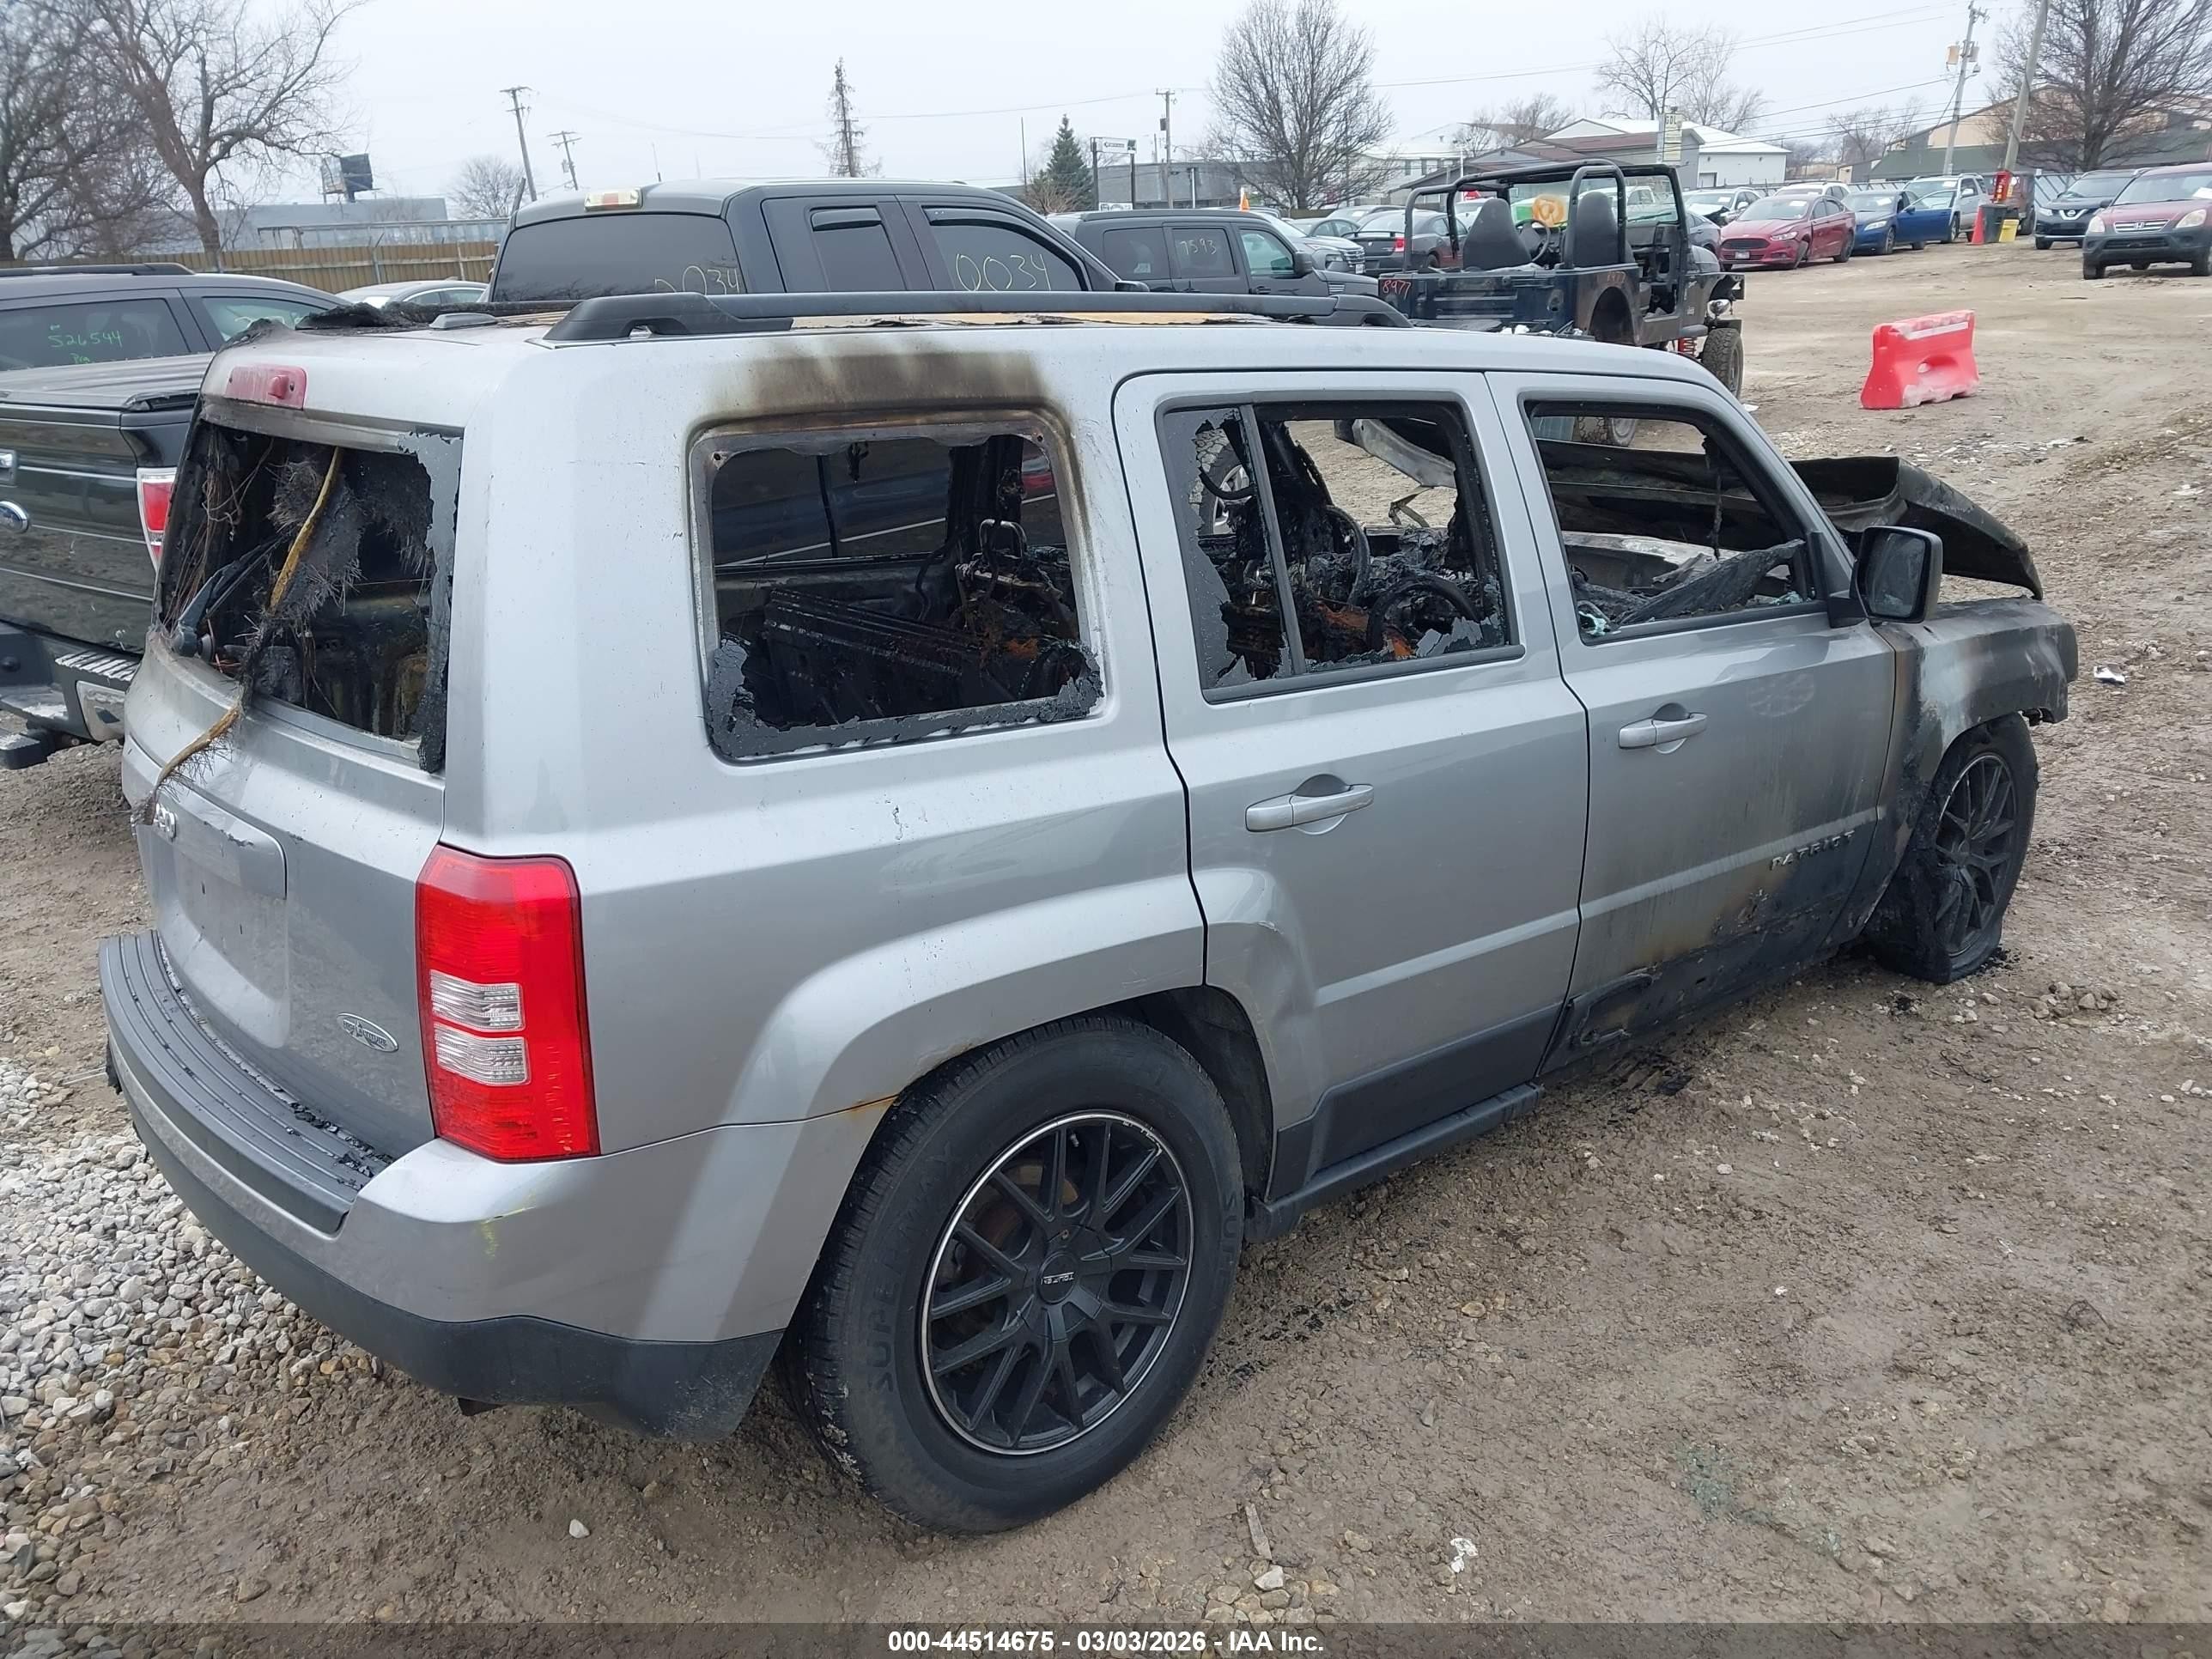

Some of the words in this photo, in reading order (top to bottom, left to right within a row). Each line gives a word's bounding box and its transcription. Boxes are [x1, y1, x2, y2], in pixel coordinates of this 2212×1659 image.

[1382, 279, 1412, 300] 8977
[48, 330, 123, 348] 526544
[1770, 830, 1855, 871] PATRIOT
